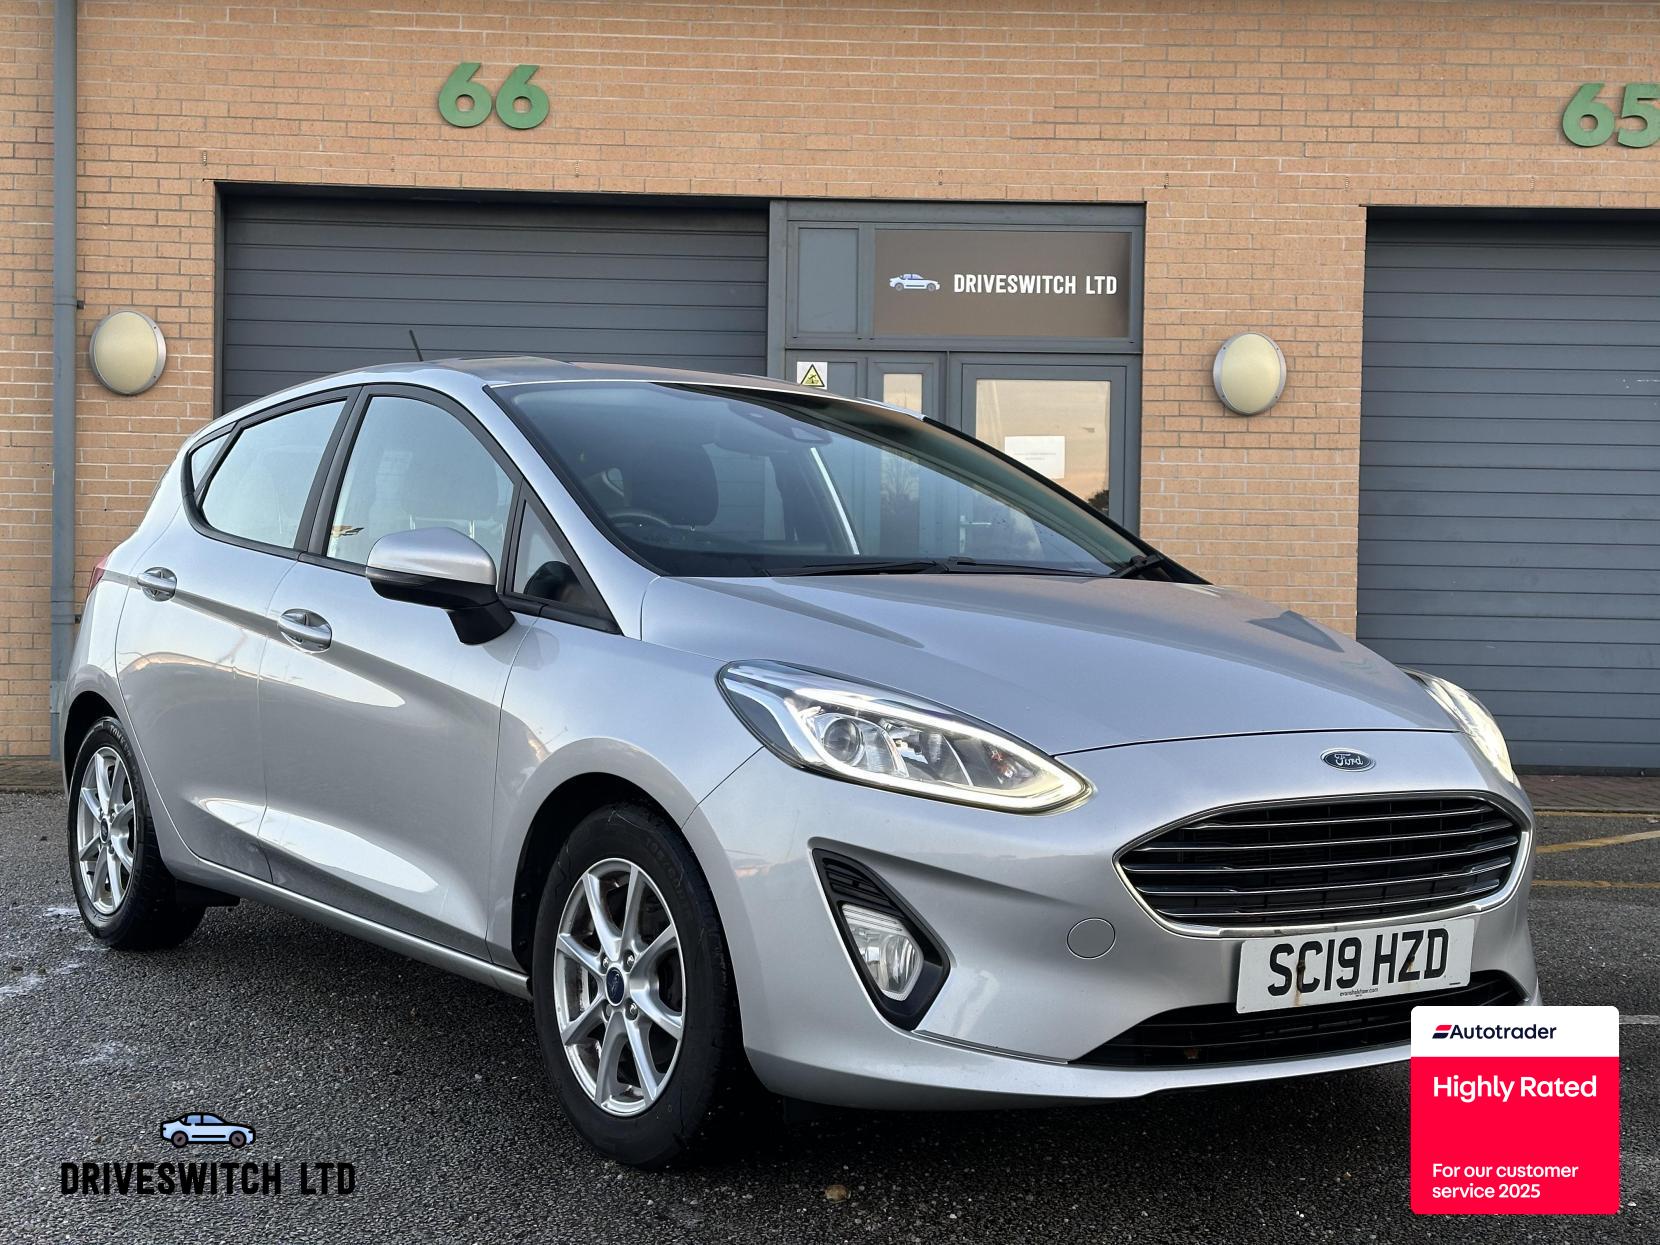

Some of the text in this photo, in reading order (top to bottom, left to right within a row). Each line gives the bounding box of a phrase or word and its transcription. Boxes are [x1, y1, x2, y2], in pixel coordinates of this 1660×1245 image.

[438, 61, 549, 130] 66
[1562, 82, 1660, 148] 65
[953, 274, 1118, 295] DRIVESWITCH LTD
[1334, 753, 1364, 767] Ford
[1267, 927, 1449, 997] SC19 HZD
